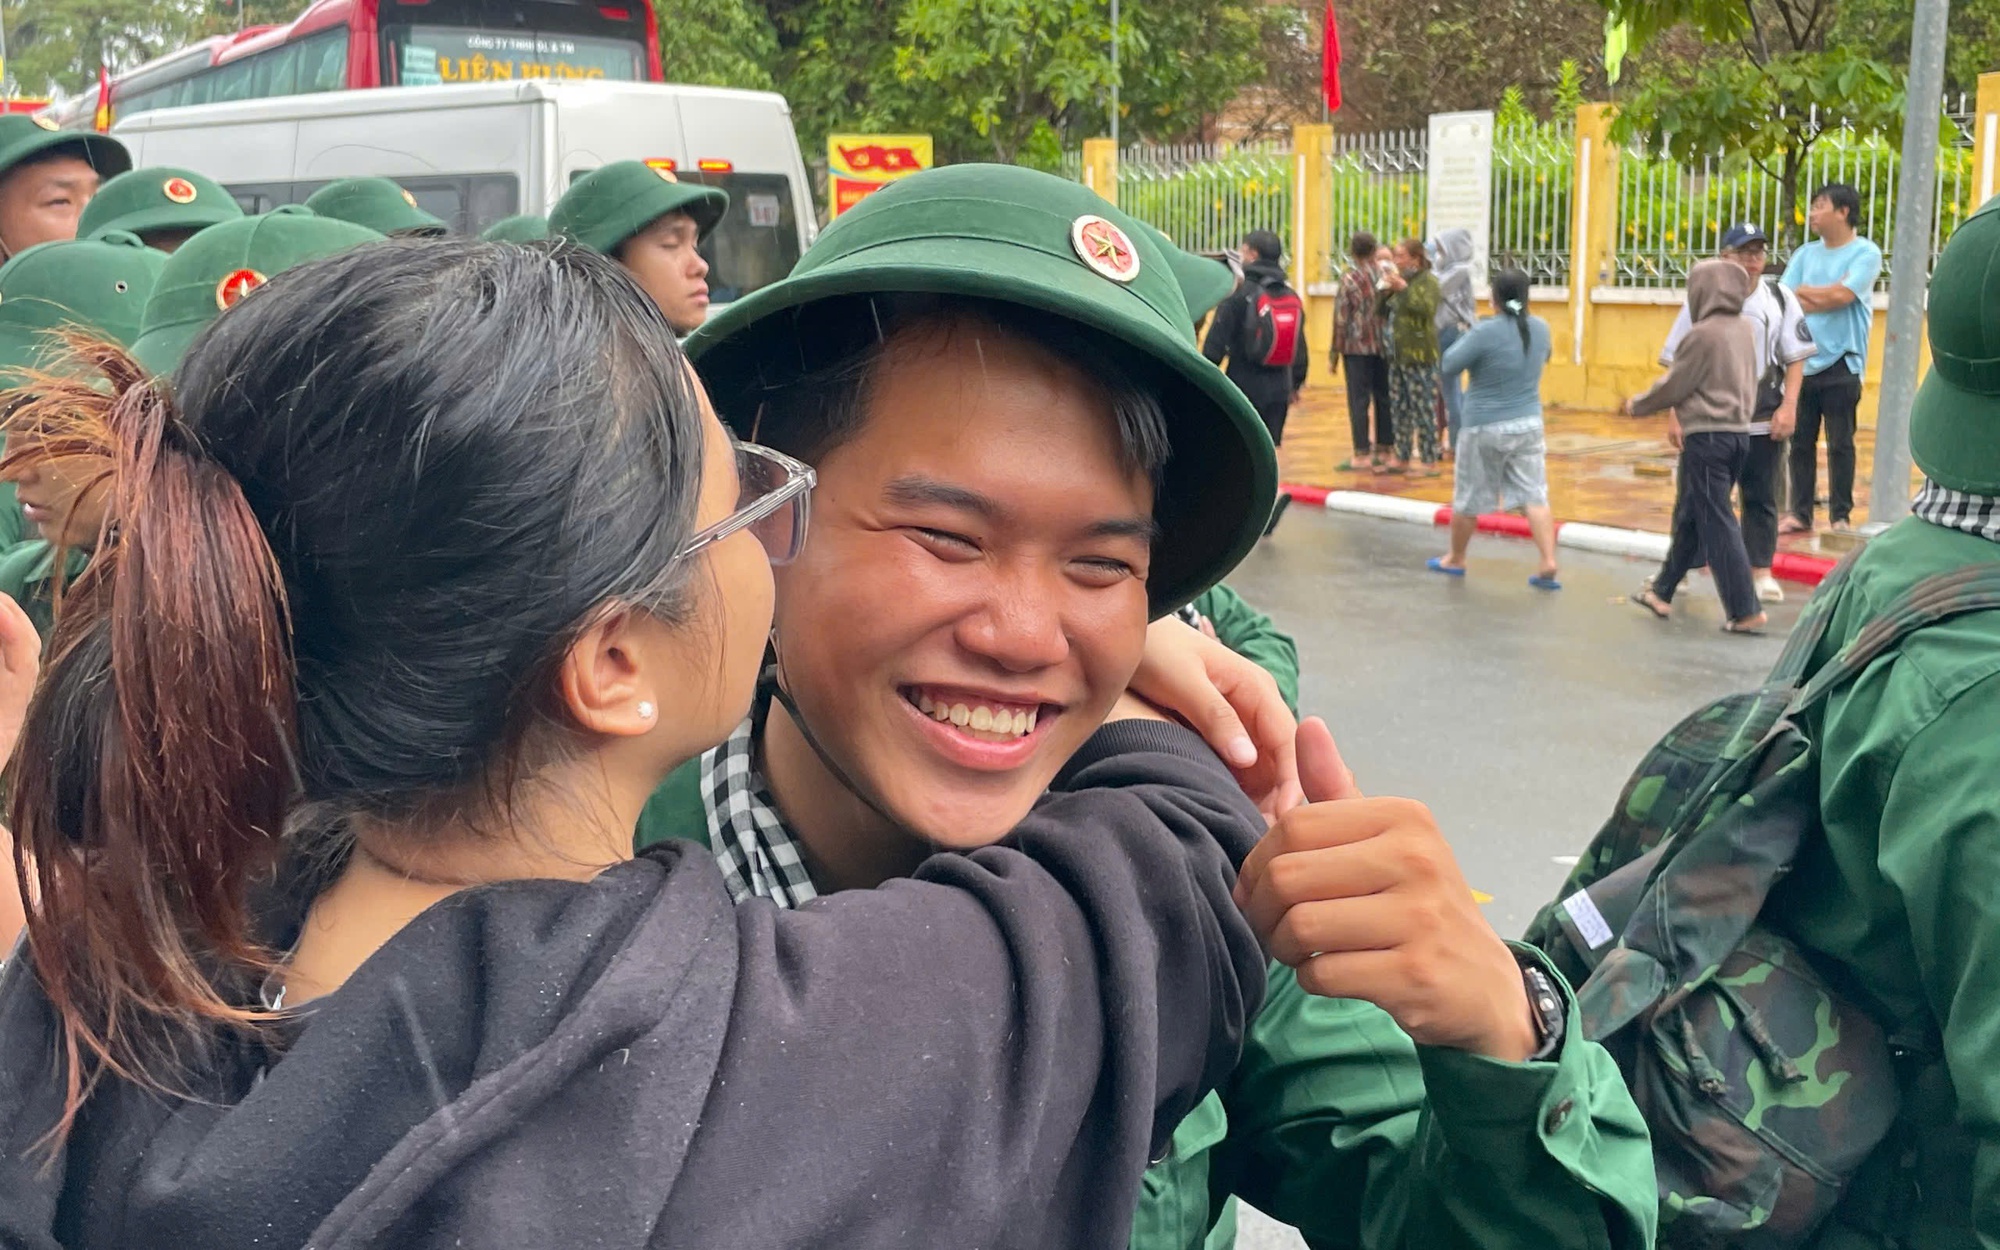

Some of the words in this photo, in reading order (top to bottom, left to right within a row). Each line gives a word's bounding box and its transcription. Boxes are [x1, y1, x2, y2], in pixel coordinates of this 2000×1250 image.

[467, 34, 494, 49] CÔNG
[495, 36, 508, 50] TY
[509, 37, 535, 51] TNHH
[439, 53, 513, 81] LIÊN
